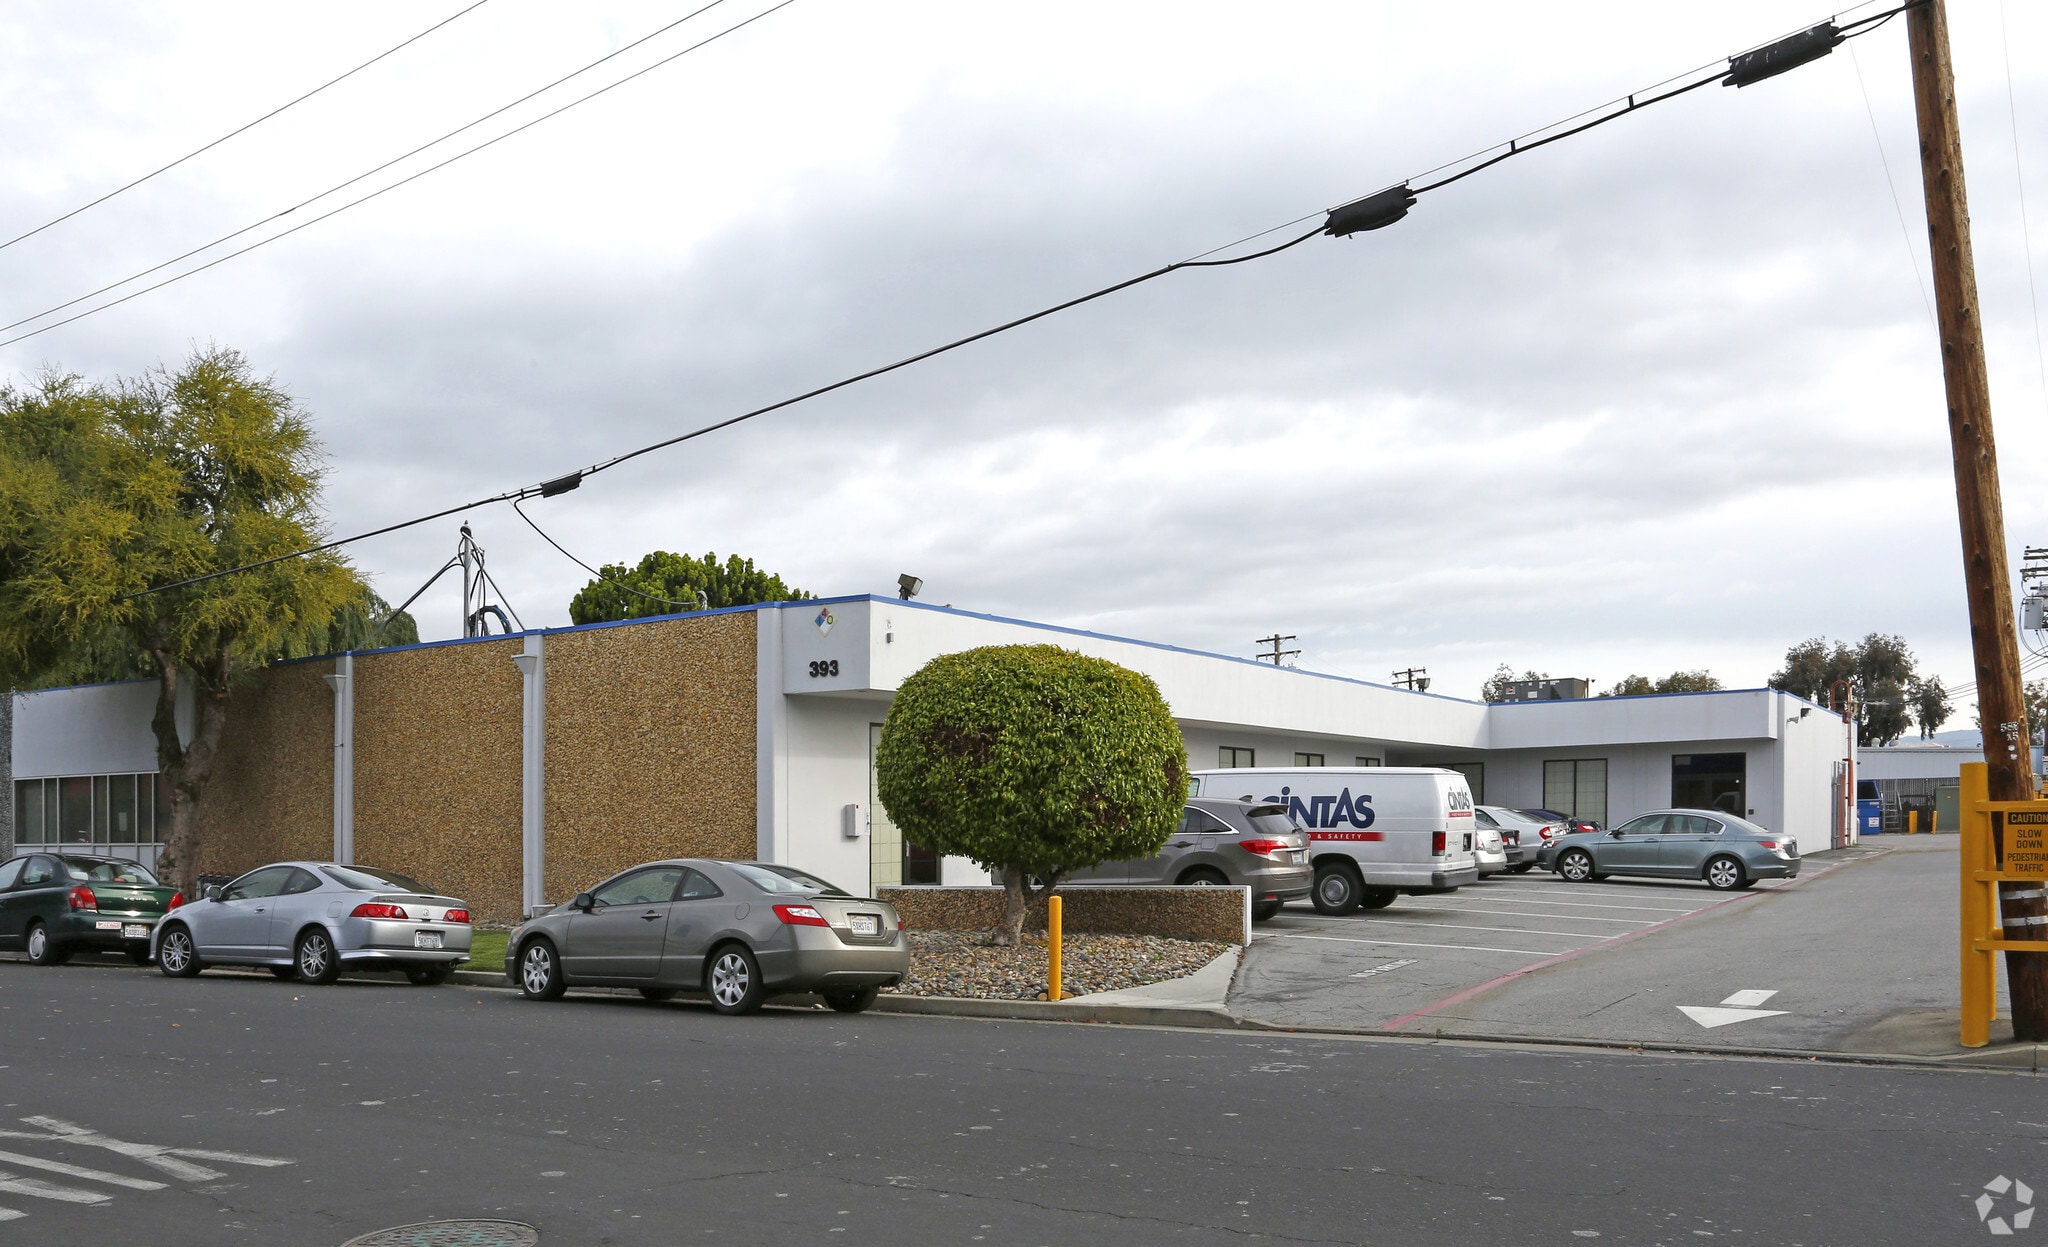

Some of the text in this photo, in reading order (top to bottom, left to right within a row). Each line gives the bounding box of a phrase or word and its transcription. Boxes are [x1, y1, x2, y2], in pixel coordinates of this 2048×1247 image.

[809, 659, 839, 678] 393
[2011, 814, 2048, 823] CAUTION
[2017, 829, 2042, 838] SLOW
[2016, 840, 2043, 849] DOWN
[2007, 853, 2048, 861] PEDESTRIA
[2014, 863, 2044, 872] TRAFFIC
